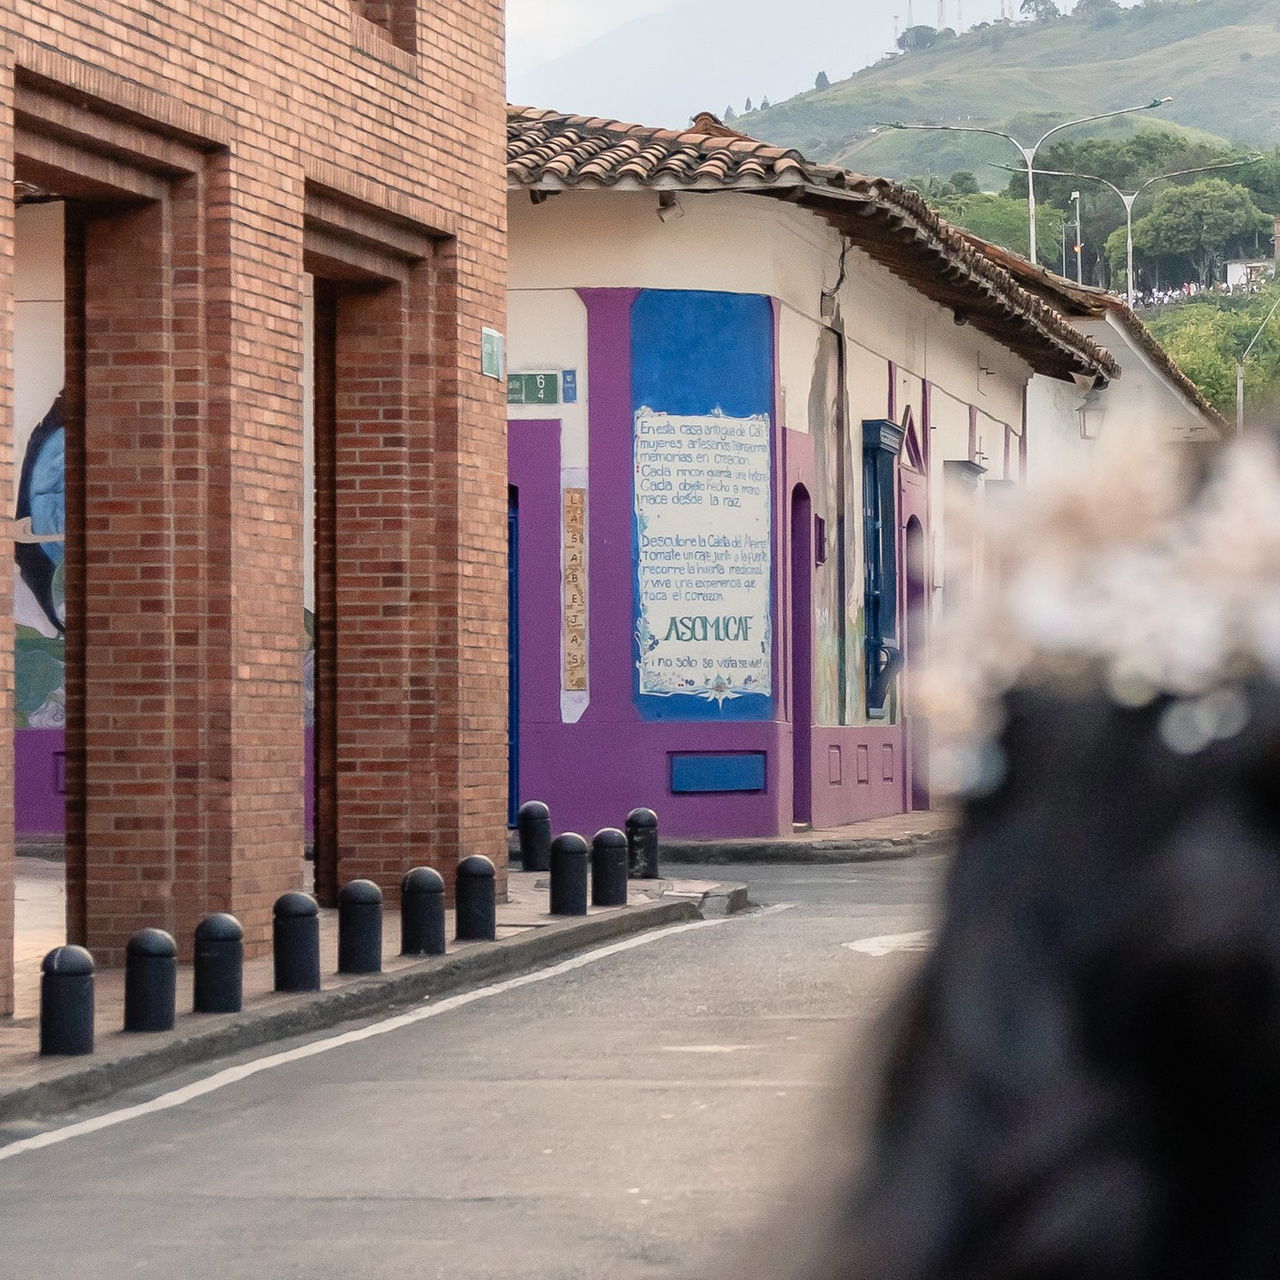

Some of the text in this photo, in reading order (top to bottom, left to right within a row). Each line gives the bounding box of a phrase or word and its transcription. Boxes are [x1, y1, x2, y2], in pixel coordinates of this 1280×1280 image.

[538, 389, 544, 400] 4
[641, 421, 655, 434] En
[656, 421, 675, 434] esta
[680, 424, 702, 436] casa
[704, 423, 735, 441] antigua
[736, 423, 745, 436] de
[640, 439, 682, 452] mujeres
[687, 437, 730, 451] artesanas
[640, 452, 693, 463] memorias
[696, 453, 709, 463] en
[641, 464, 671, 477] Cada
[640, 478, 760, 495] Cada objeto hecho a mano
[640, 494, 668, 505] nace
[671, 491, 703, 505] desde
[710, 493, 719, 506] la
[641, 534, 697, 548] Descubre
[698, 534, 706, 547] la
[683, 551, 693, 560] un
[734, 554, 739, 562] a
[642, 565, 685, 575] recorre
[687, 562, 695, 574] la
[696, 563, 725, 575] huerta
[643, 579, 650, 589] y
[651, 579, 672, 588] vive
[675, 579, 694, 589] una
[643, 590, 668, 601] toca
[672, 590, 682, 601] el
[676, 656, 698, 668] solo
[702, 658, 714, 668] se
[738, 658, 748, 668] se
